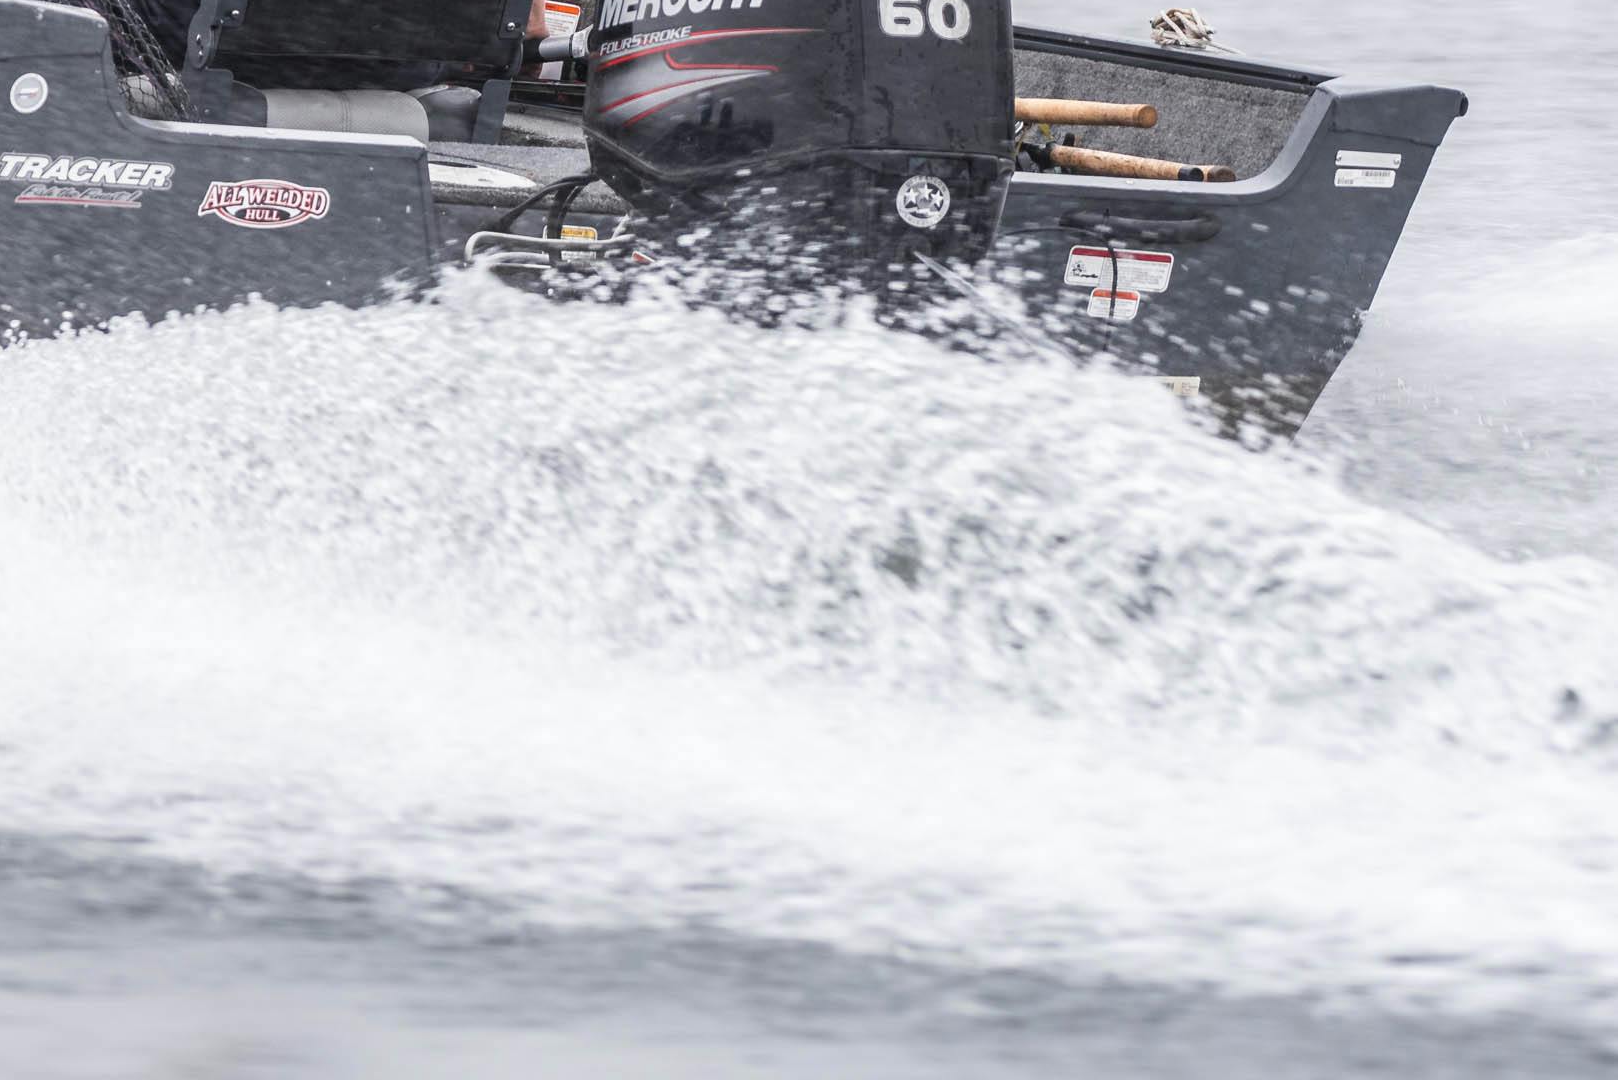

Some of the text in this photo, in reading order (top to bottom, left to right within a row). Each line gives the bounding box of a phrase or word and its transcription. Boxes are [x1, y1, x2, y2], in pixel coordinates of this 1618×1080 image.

[599, 25, 693, 56] FOURSTROKE
[202, 183, 328, 215] ALL WELDED
[245, 208, 281, 221] HULL
